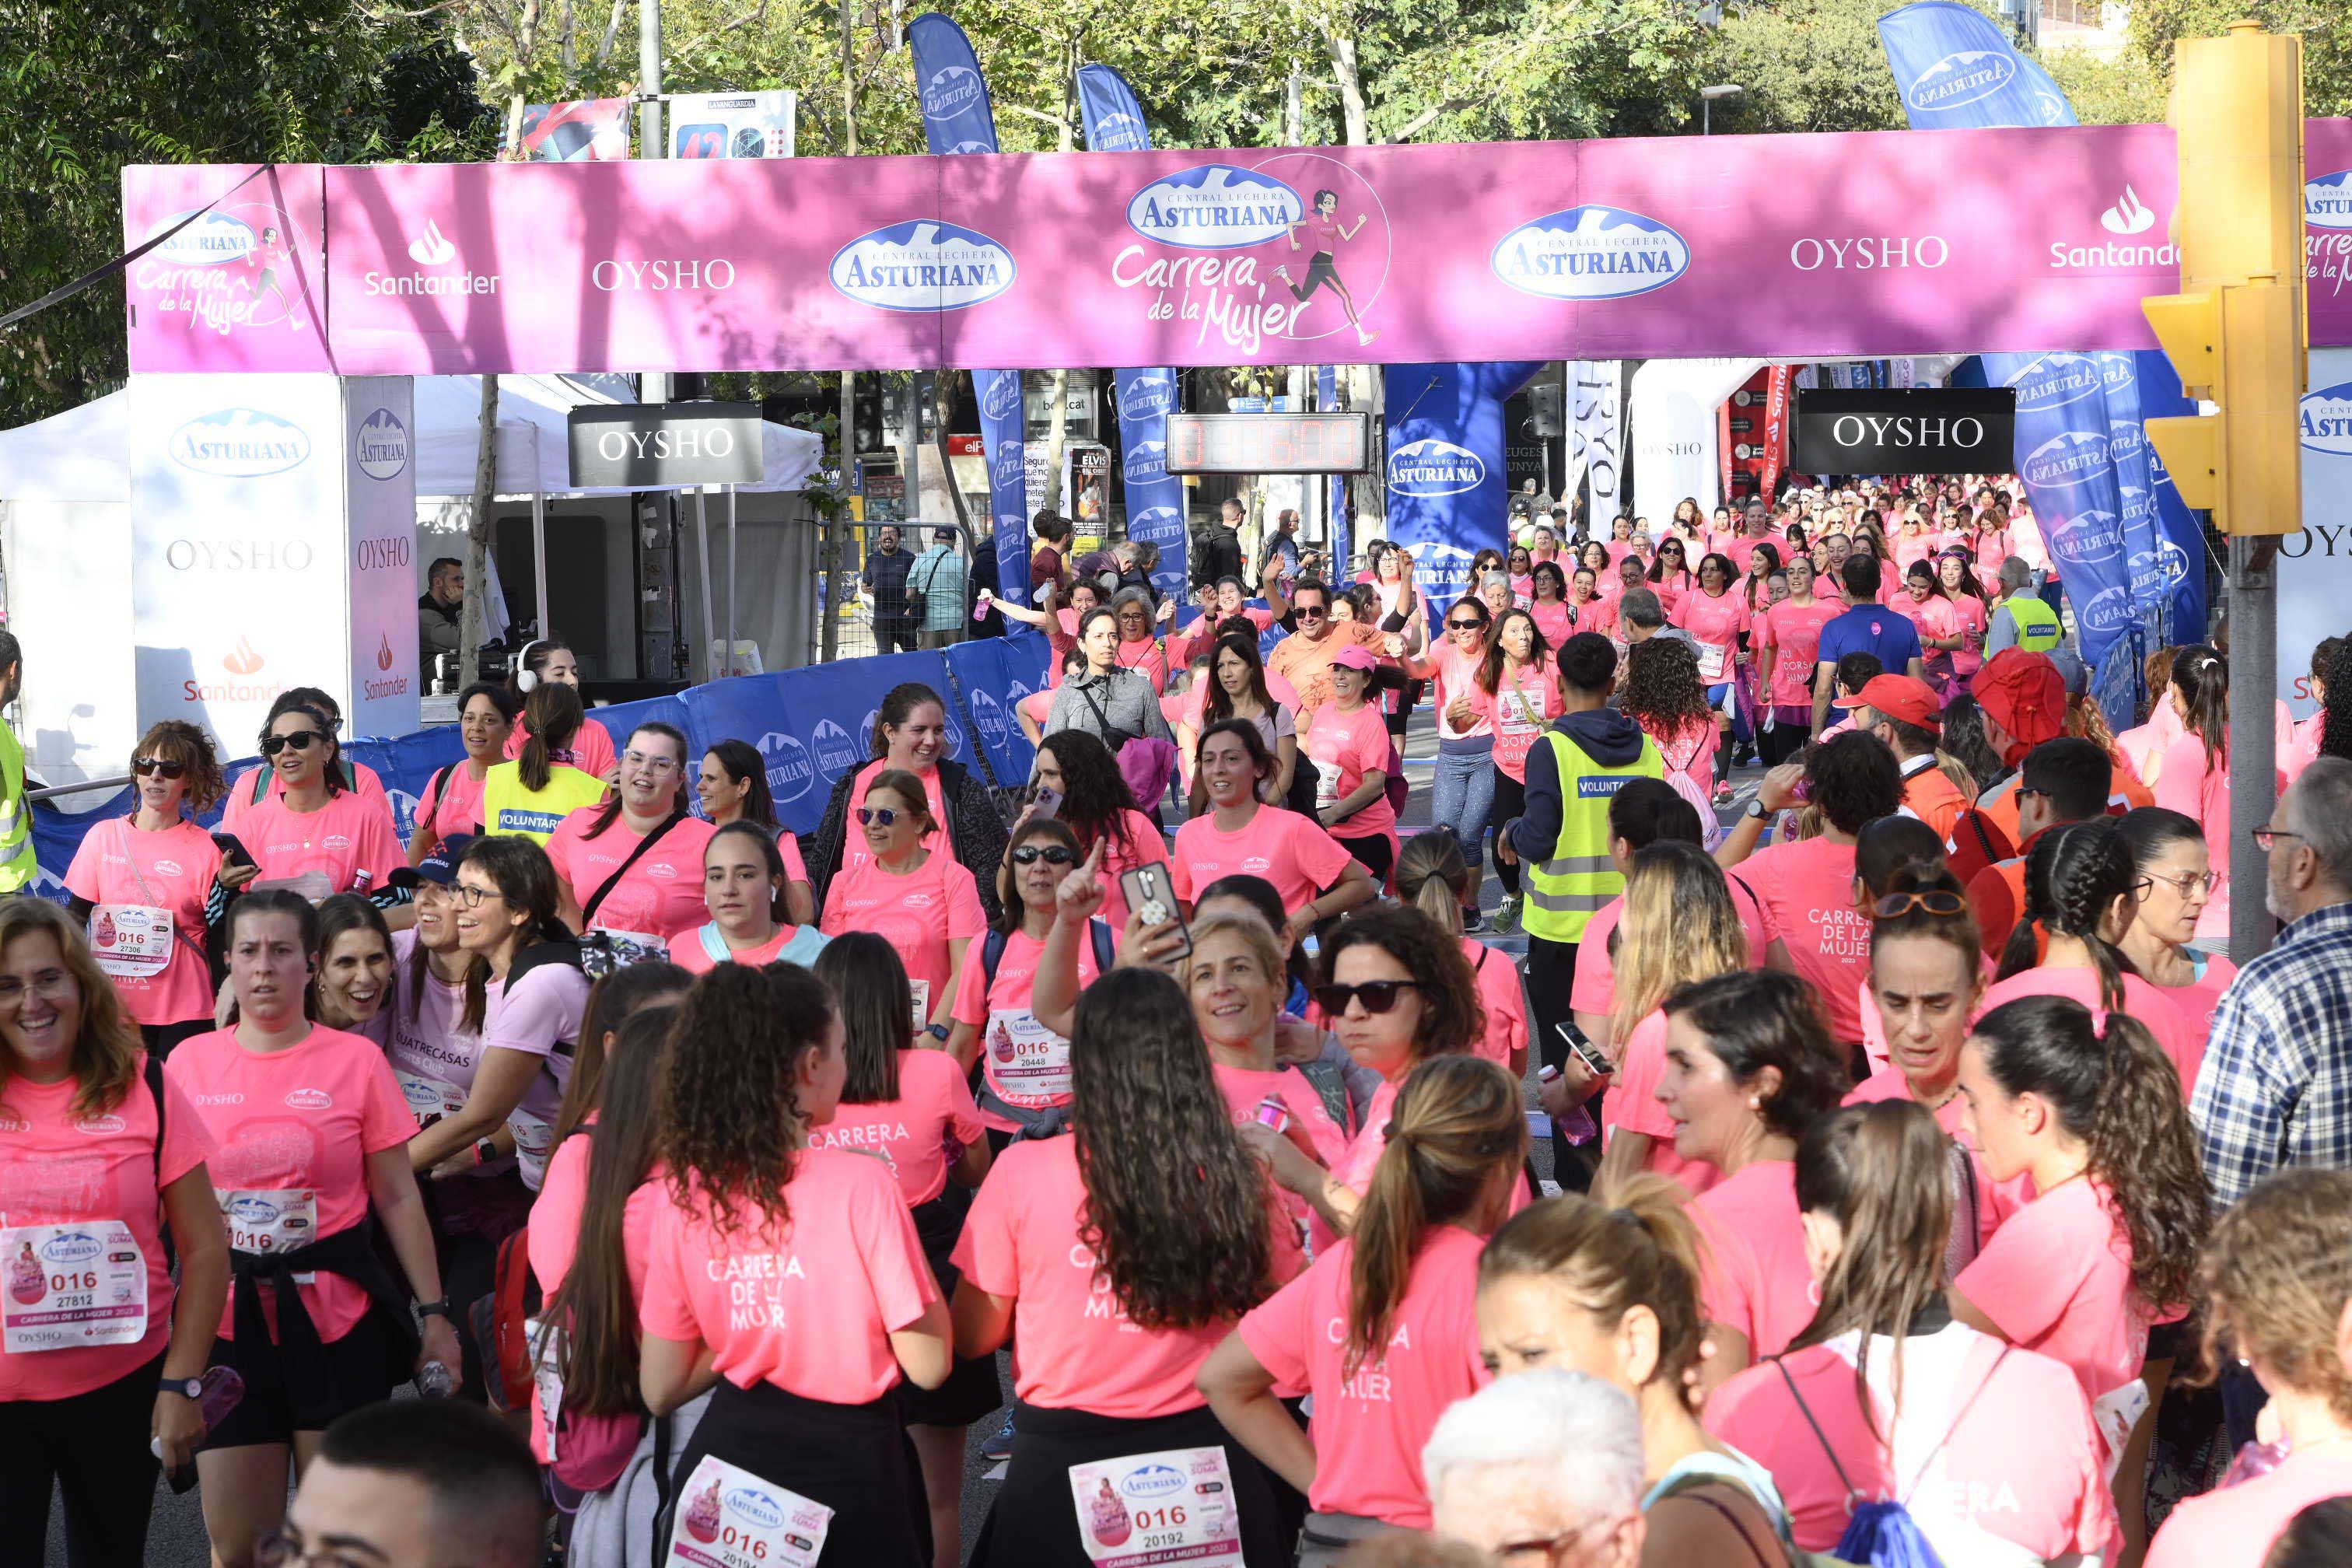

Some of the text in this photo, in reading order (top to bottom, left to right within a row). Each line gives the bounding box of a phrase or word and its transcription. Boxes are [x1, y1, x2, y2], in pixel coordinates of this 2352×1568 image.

[1167, 192, 1285, 202] CENTRAL LECHERA
[1140, 196, 1290, 228] ASTURIANA
[1537, 236, 1668, 247] CENTRAL LECHERA
[872, 250, 996, 261] CENTRAL LECHERA
[1509, 242, 1675, 276] ASTURIANA
[1790, 236, 1949, 270] OYSHO
[135, 260, 229, 291] Carrera
[591, 259, 736, 292] OYSHO
[843, 254, 1003, 288] ASTURIANA
[1111, 244, 1258, 289] Carrera
[364, 271, 500, 296] Santander
[159, 289, 263, 336] de la Mujer
[1147, 282, 1312, 356] de la Mujer
[1832, 415, 1983, 448] OYSHO
[181, 435, 299, 460] ASTURIANA
[359, 436, 405, 464] ASTURIANA
[598, 427, 734, 461] OYSHO
[1082, 455, 1106, 465] ELVIS
[1389, 463, 1478, 485] ASTURIANA
[166, 539, 313, 571] OYSHO
[358, 535, 410, 571] OYSHO
[1414, 569, 1472, 584] TURIAN
[364, 677, 408, 702] Santander
[1500, 733, 1535, 747] DORS
[817, 749, 856, 772] ASTURIANA
[1504, 750, 1528, 761] SUM
[765, 759, 811, 788] STURIANA
[265, 842, 298, 854] OYSHO
[118, 932, 145, 944] 016
[1822, 924, 1871, 940] DE LA
[120, 945, 141, 954] 27306
[1818, 940, 1871, 957] MUJE
[996, 968, 1027, 978] YSHO
[395, 1031, 470, 1068] CUATRECASAS
[1017, 1041, 1049, 1055] 016
[422, 1057, 445, 1074] Club
[1021, 1058, 1046, 1067] 20448
[195, 1094, 244, 1107] OYSHO
[807, 1122, 911, 1150] CARRERA
[107, 1235, 133, 1245] SUMA
[236, 1230, 272, 1248] 016
[46, 1244, 97, 1257] ASTURIANA
[51, 1272, 98, 1292] 016
[56, 1293, 93, 1308] 27812
[730, 1282, 756, 1307] DE
[20, 1314, 61, 1325] CARRERA
[61, 1312, 74, 1321] DE
[86, 1309, 114, 1319] MUJER
[17, 1324, 138, 1344] OYSHO Santander
[1127, 1465, 1219, 1492] ASTURIANA SUMA
[730, 1494, 779, 1524] ASTURIANA
[1135, 1504, 1187, 1530] 016
[722, 1525, 768, 1559] 016
[1143, 1531, 1184, 1549] 20192
[1106, 1556, 1148, 1568] CARRERA
[1149, 1553, 1163, 1562] DE
[1164, 1552, 1175, 1560] LA
[1175, 1548, 1206, 1559] MUJER
